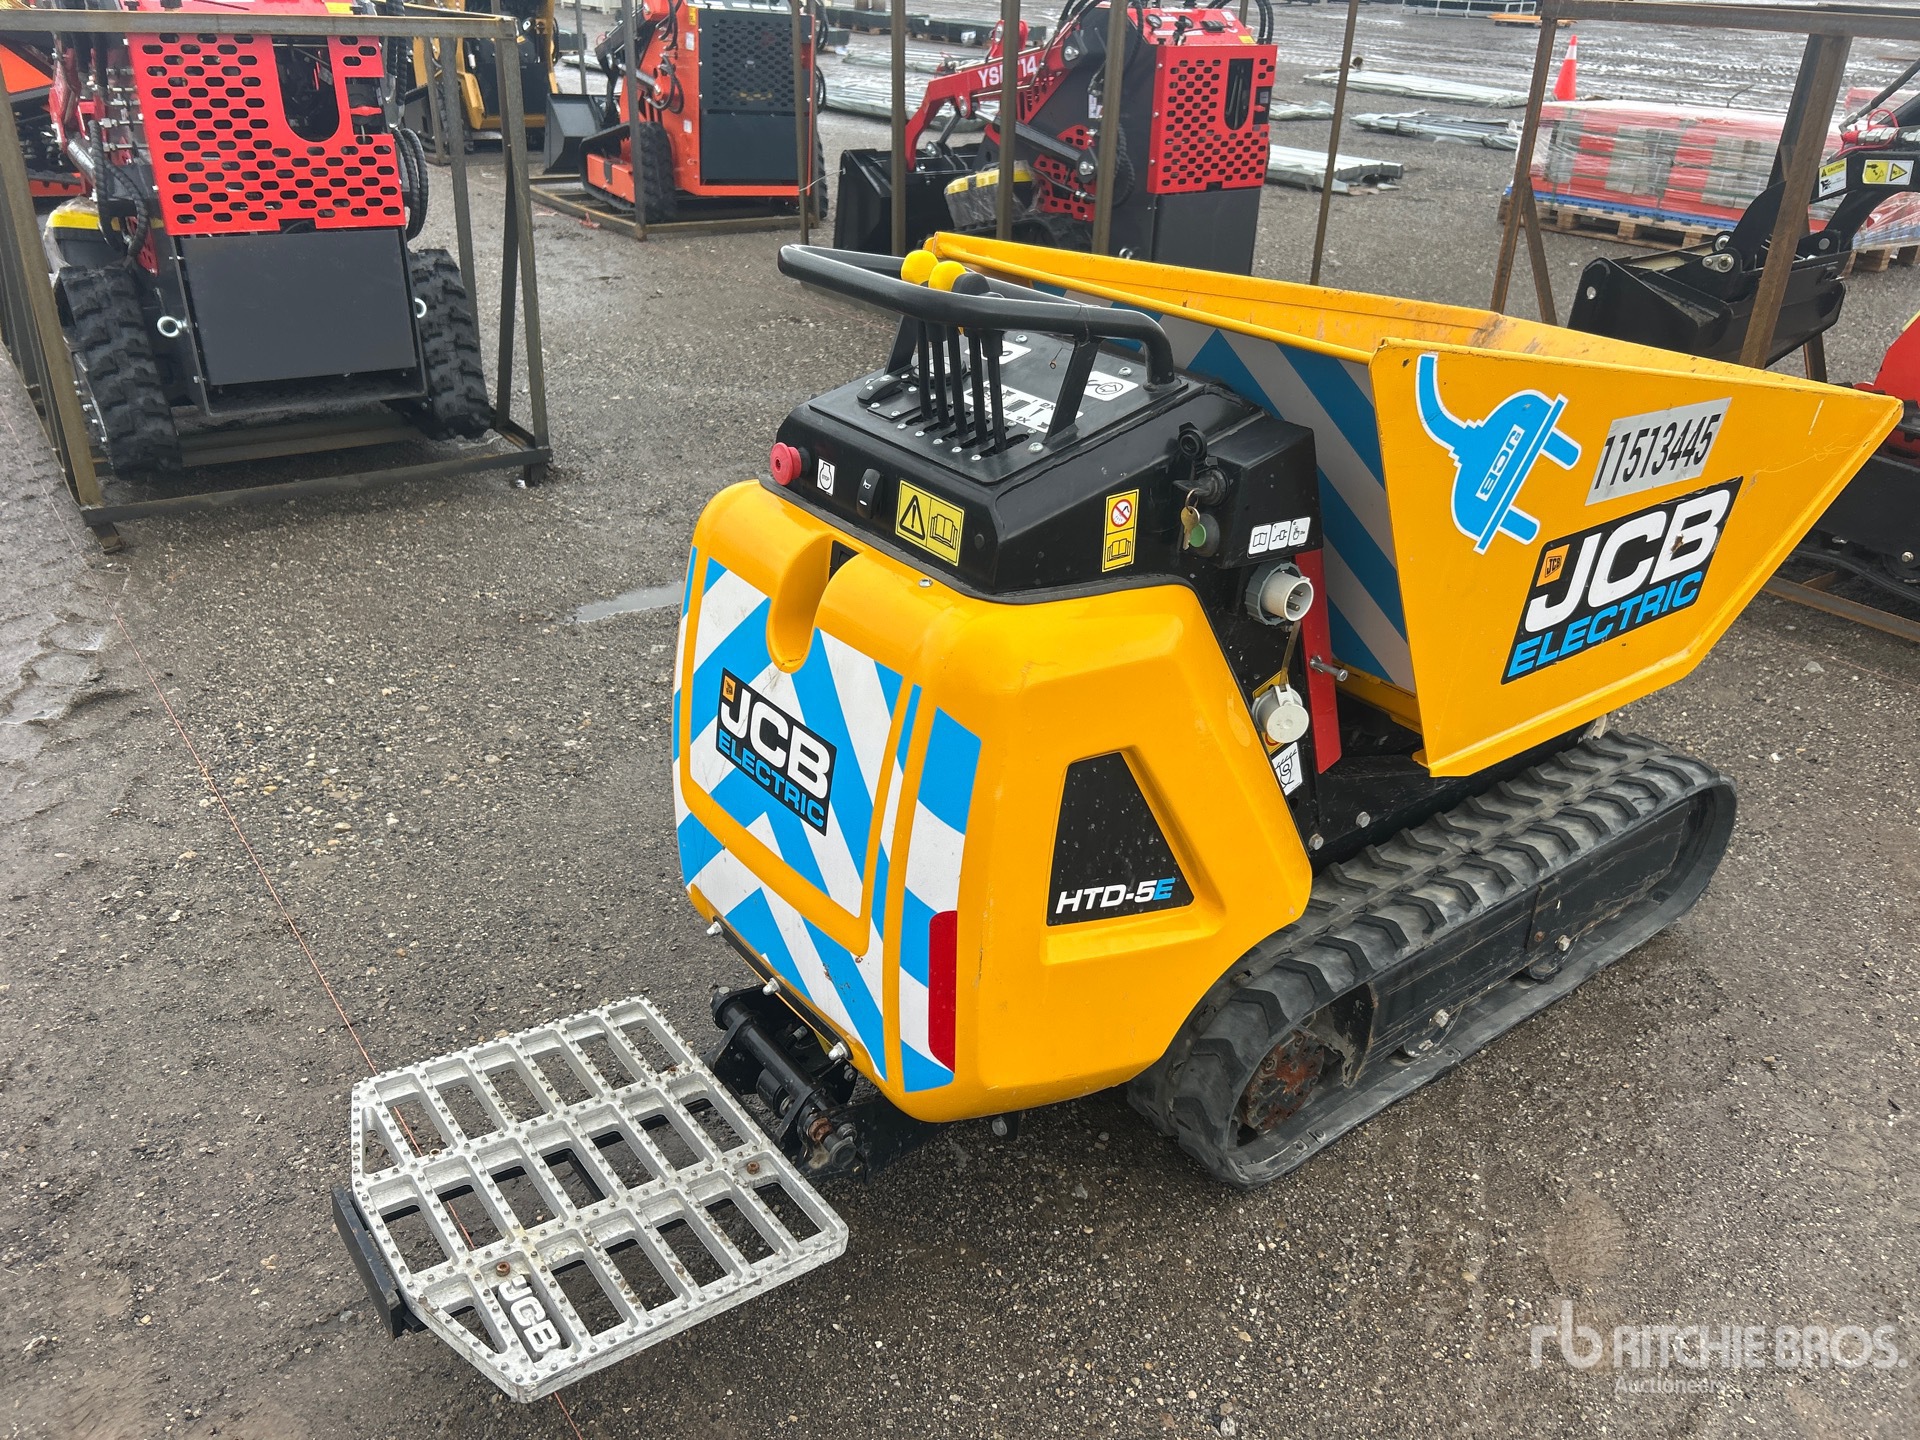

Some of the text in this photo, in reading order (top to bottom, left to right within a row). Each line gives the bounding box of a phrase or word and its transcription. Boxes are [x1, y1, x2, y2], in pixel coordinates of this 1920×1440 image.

[1480, 430, 1521, 496] JCB
[1594, 414, 1721, 490] 11513445
[1525, 490, 1730, 633] JCB
[1508, 571, 1703, 677] ELECTRIC
[718, 728, 825, 828] ELECTRIC
[721, 688, 830, 799] JCB
[1055, 877, 1176, 914] HTD-5E
[499, 1275, 561, 1352] JCB
